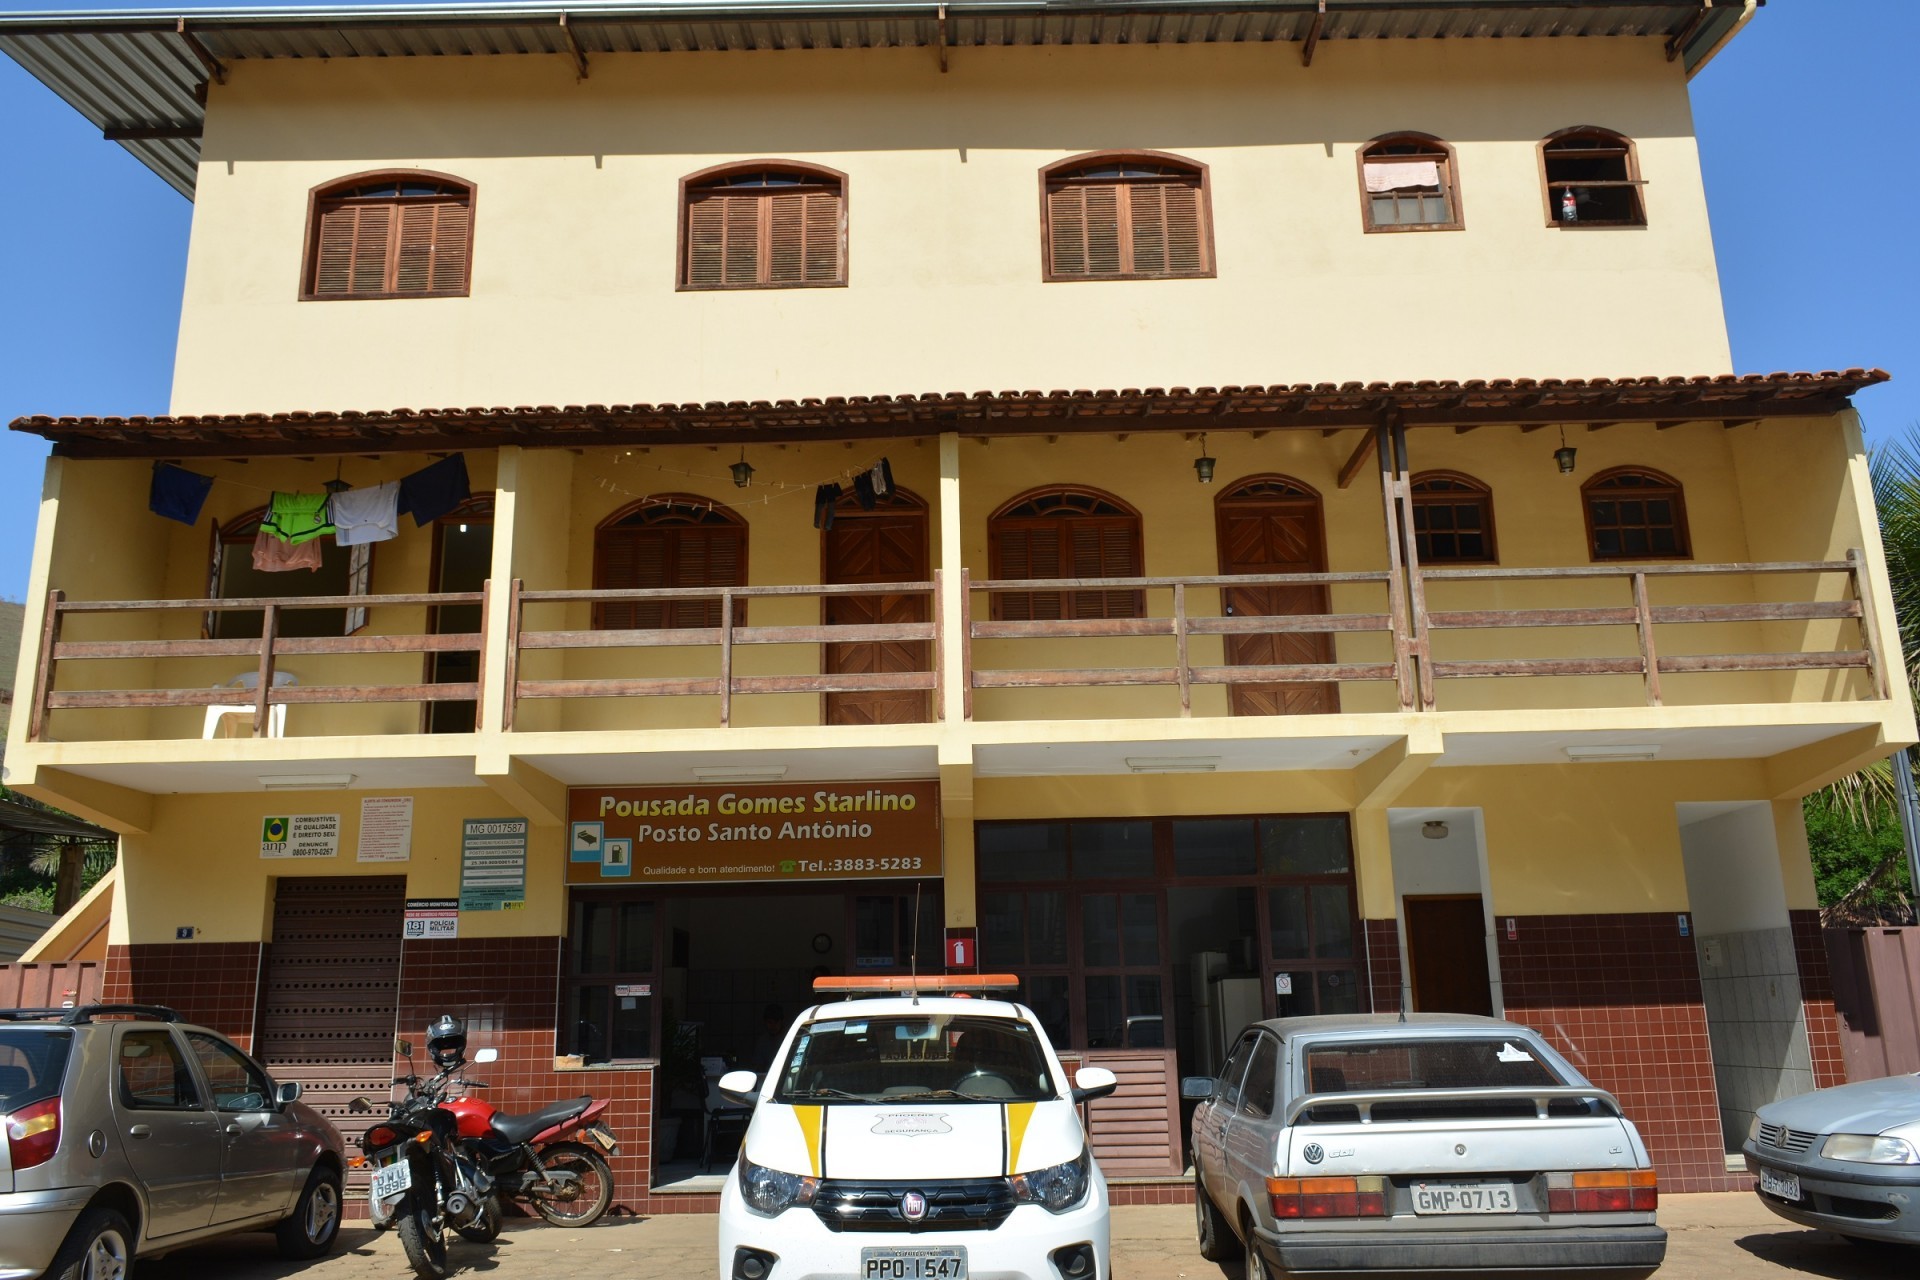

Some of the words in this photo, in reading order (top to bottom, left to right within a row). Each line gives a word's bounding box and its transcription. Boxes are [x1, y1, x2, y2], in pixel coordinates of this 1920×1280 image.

[599, 794, 710, 818] Pousada
[717, 793, 806, 815] Gomes
[813, 789, 916, 813] Starlino
[295, 815, 337, 823] COMBUSTÍVEL
[470, 824, 485, 834] MG
[487, 823, 523, 834] 0017587
[638, 824, 701, 842] Posto
[707, 822, 772, 841] Santo
[777, 819, 872, 840] Antônio
[262, 842, 287, 853] anp
[292, 848, 334, 856] 0800-970-0267
[643, 865, 687, 875] Qualidade
[698, 865, 717, 874] bom
[719, 864, 775, 873] atendimento!
[407, 921, 424, 930] 181
[907, 1200, 922, 1212] FIAT
